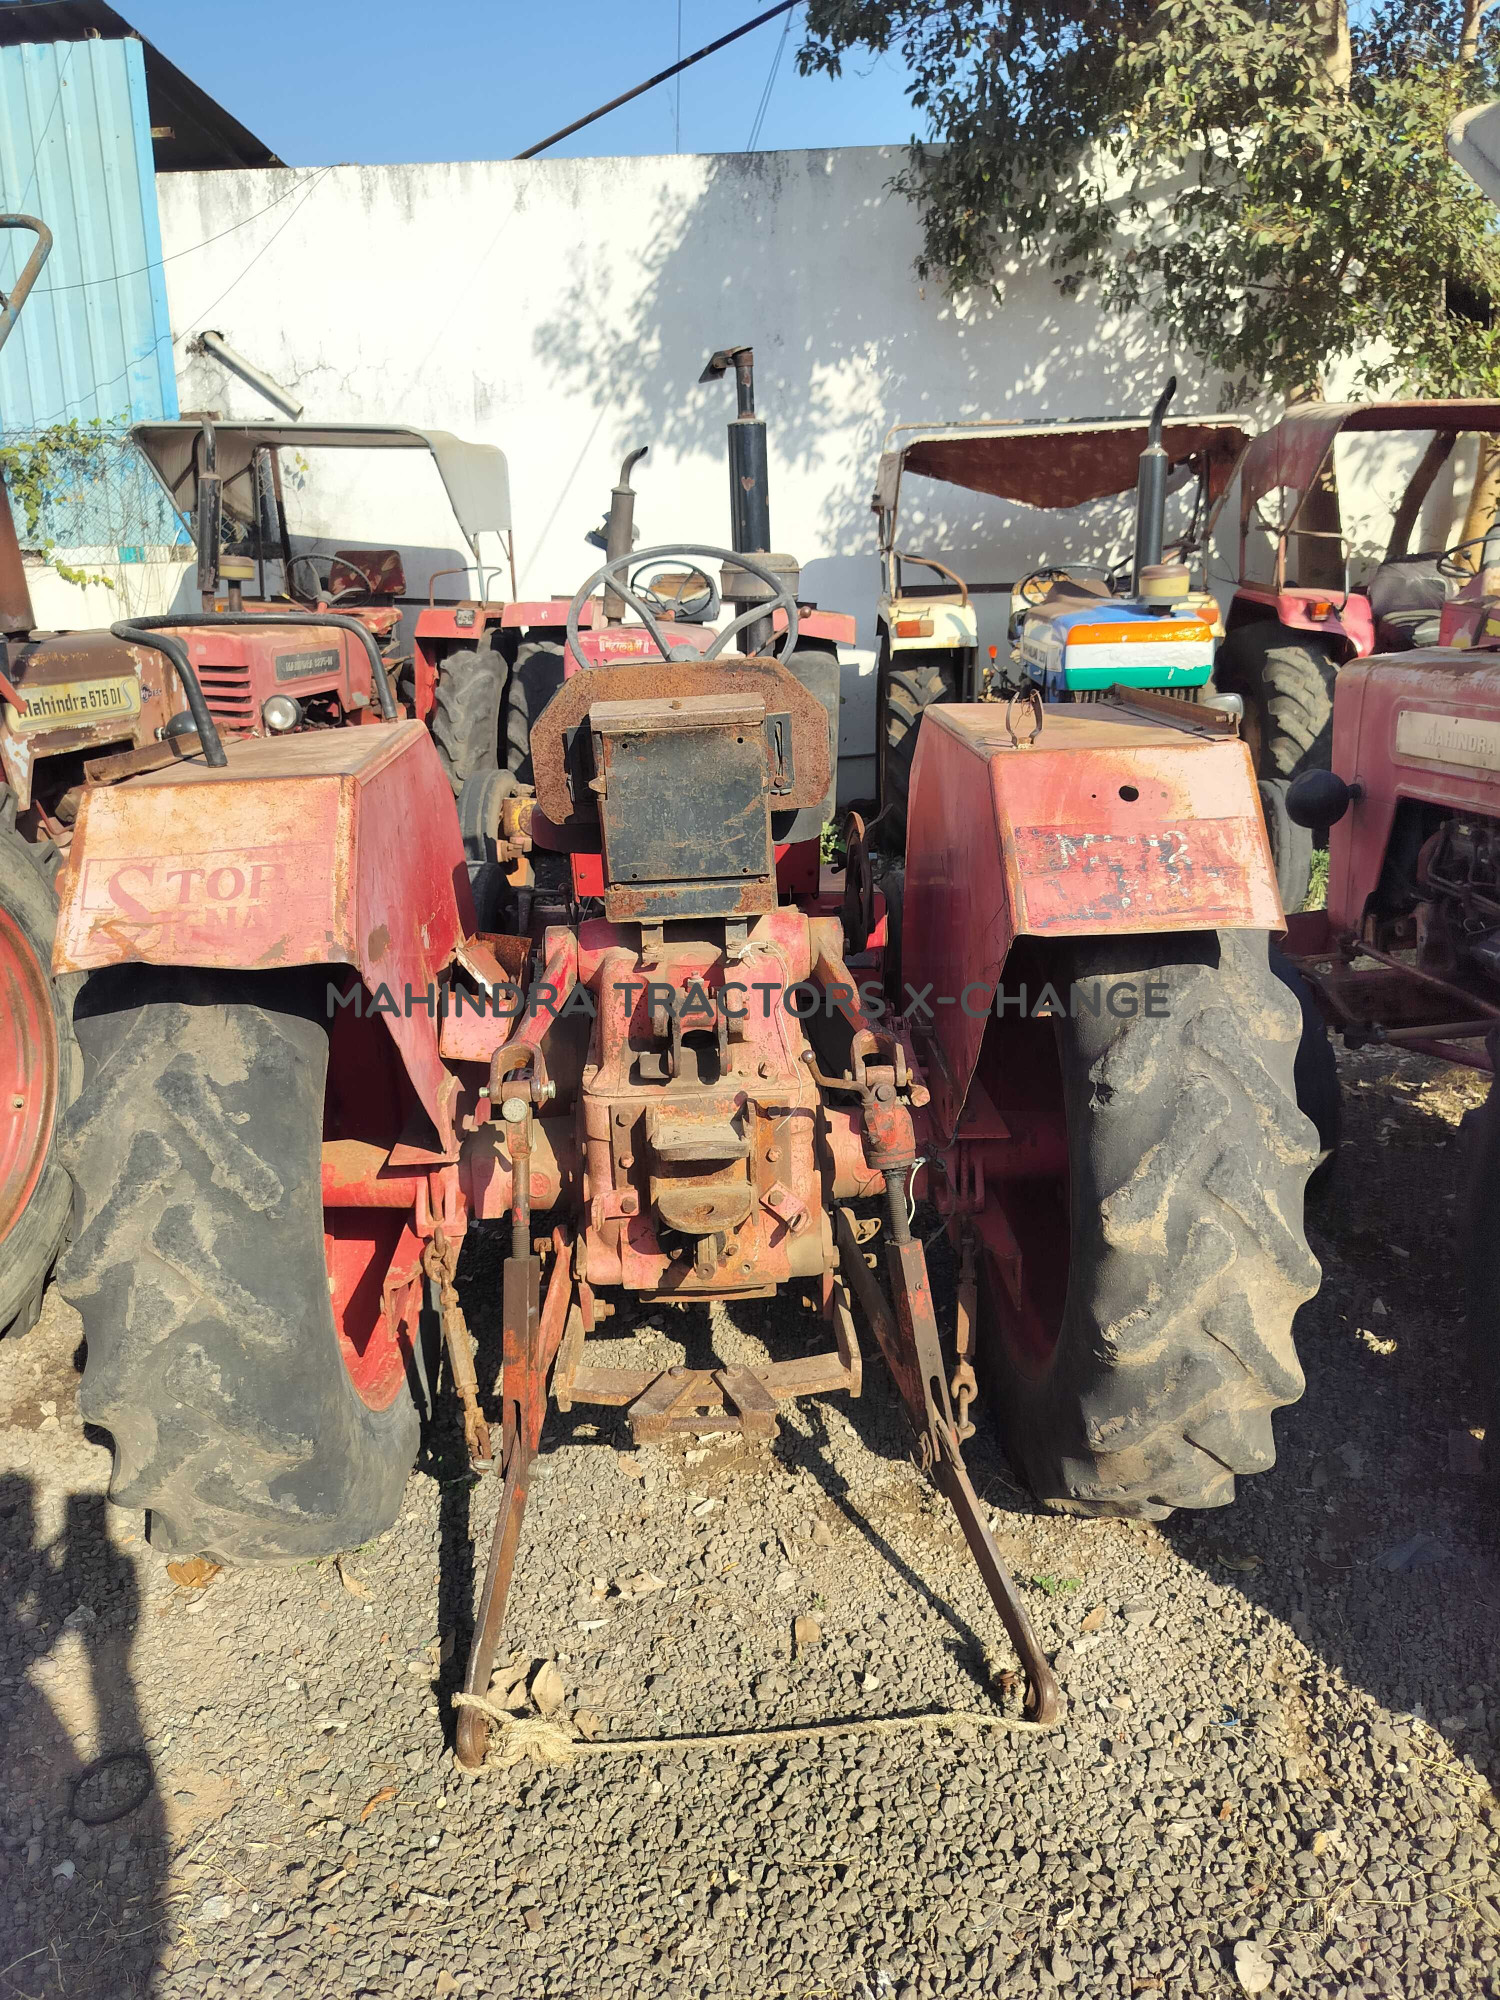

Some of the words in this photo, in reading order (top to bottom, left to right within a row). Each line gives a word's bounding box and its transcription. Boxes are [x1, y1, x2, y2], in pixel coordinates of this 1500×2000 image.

[88, 688, 108, 708] 575
[109, 687, 122, 704] DI
[1422, 720, 1497, 756] MAHINDRA
